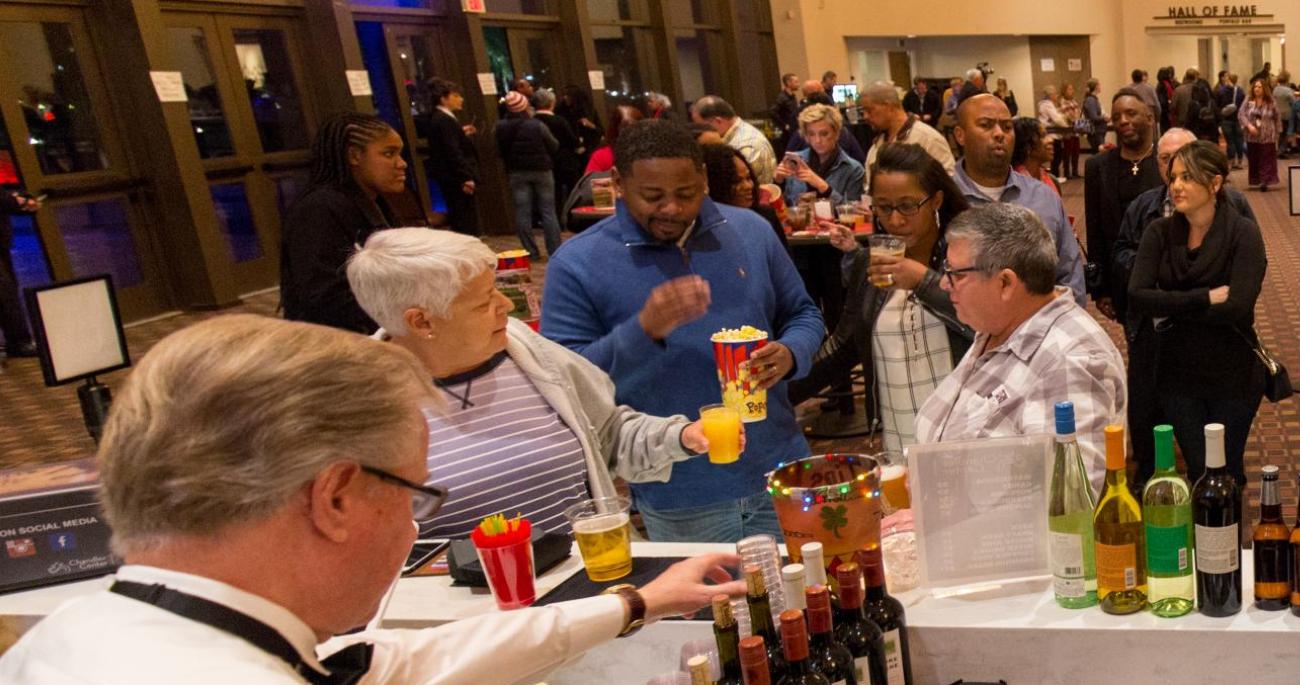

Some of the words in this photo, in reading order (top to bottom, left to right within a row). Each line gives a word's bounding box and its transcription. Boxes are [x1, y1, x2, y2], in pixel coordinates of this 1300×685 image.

[1168, 6, 1198, 18] HALL
[1202, 6, 1219, 17] OF
[1223, 5, 1257, 17] FAME
[0, 528, 16, 537] ON
[19, 522, 60, 535] SOCIAL
[62, 516, 98, 528] MEDIA
